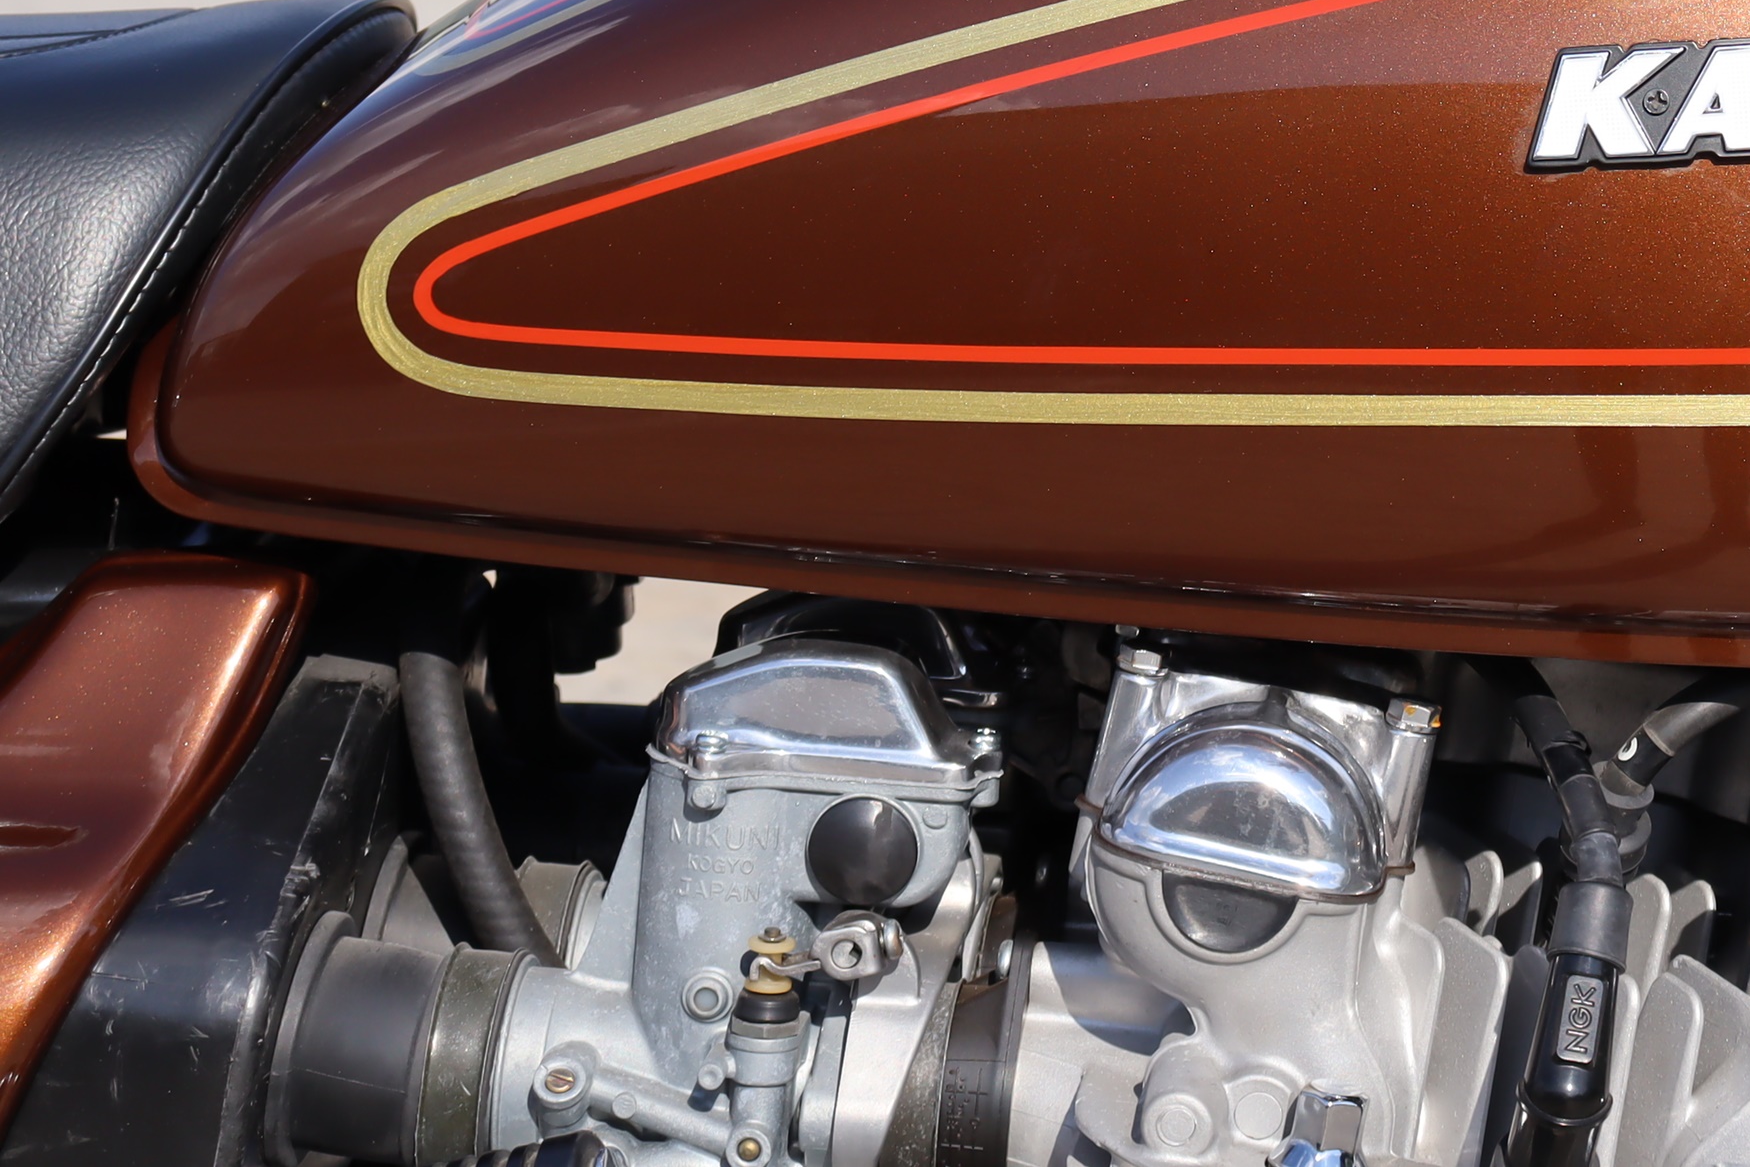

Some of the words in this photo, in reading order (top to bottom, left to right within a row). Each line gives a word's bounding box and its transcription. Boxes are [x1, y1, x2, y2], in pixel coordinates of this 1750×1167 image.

[669, 817, 781, 851] MIKUNI
[687, 852, 755, 875] KOGYO
[677, 876, 762, 903] JAPAN
[1564, 983, 1597, 1054] NGK
